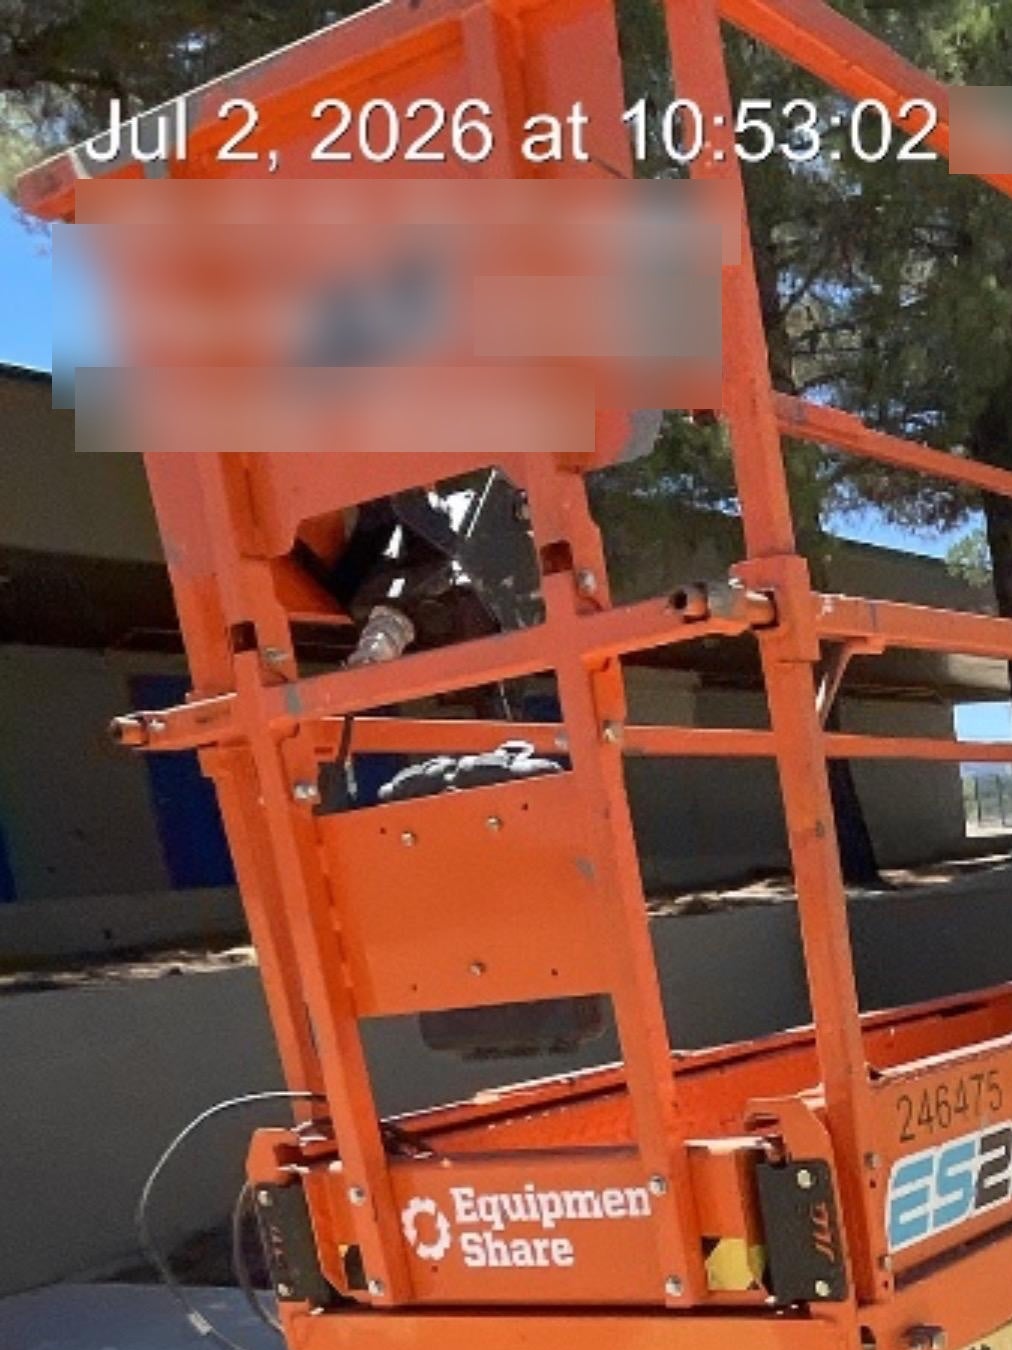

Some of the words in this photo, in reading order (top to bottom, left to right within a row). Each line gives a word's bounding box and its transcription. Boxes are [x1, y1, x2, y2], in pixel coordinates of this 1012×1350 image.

[897, 1070, 1003, 1142] 246475
[449, 1183, 652, 1231] Equipmen
[460, 1231, 575, 1267] Share
